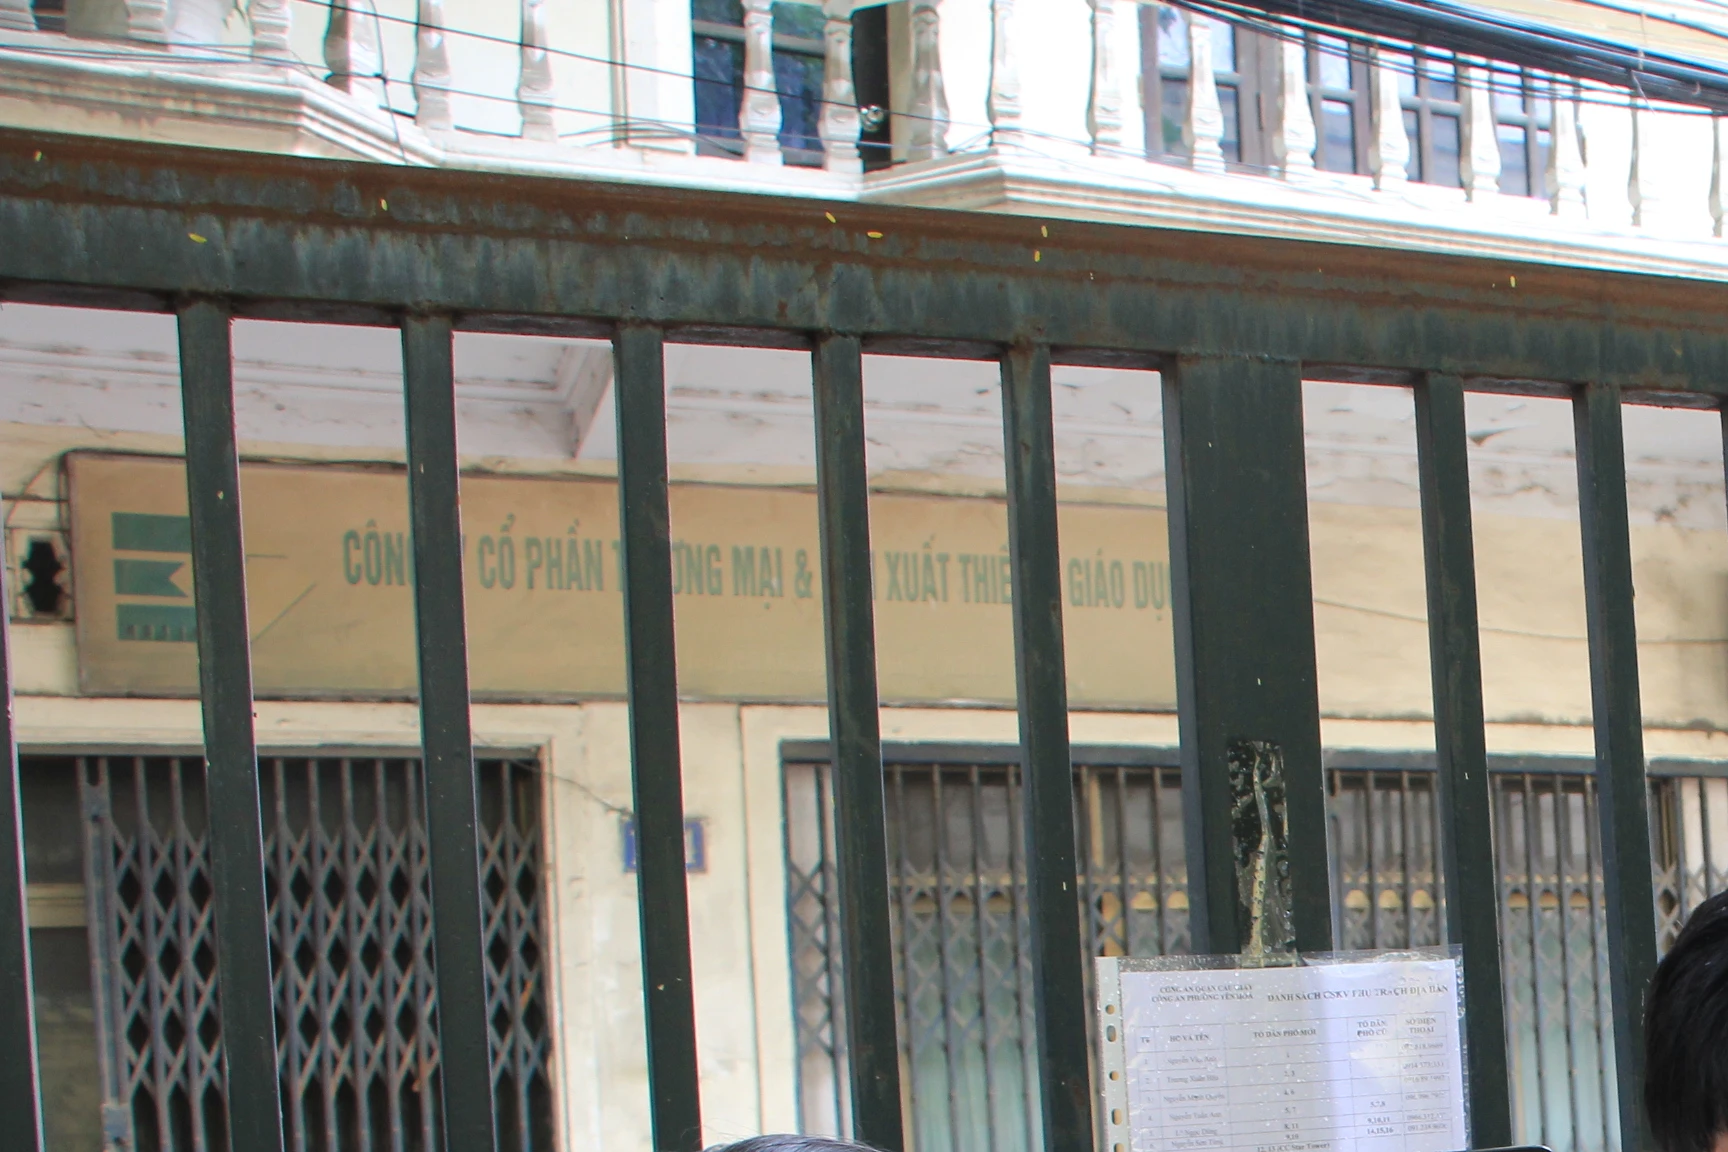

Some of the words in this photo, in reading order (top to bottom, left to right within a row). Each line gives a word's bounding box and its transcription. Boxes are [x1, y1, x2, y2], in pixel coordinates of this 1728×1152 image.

[731, 545, 783, 610] MẠI
[794, 547, 813, 599] &
[884, 534, 951, 602] XUẤT
[1067, 547, 1124, 608] GIÁO
[1267, 993, 1295, 1002] DANH
